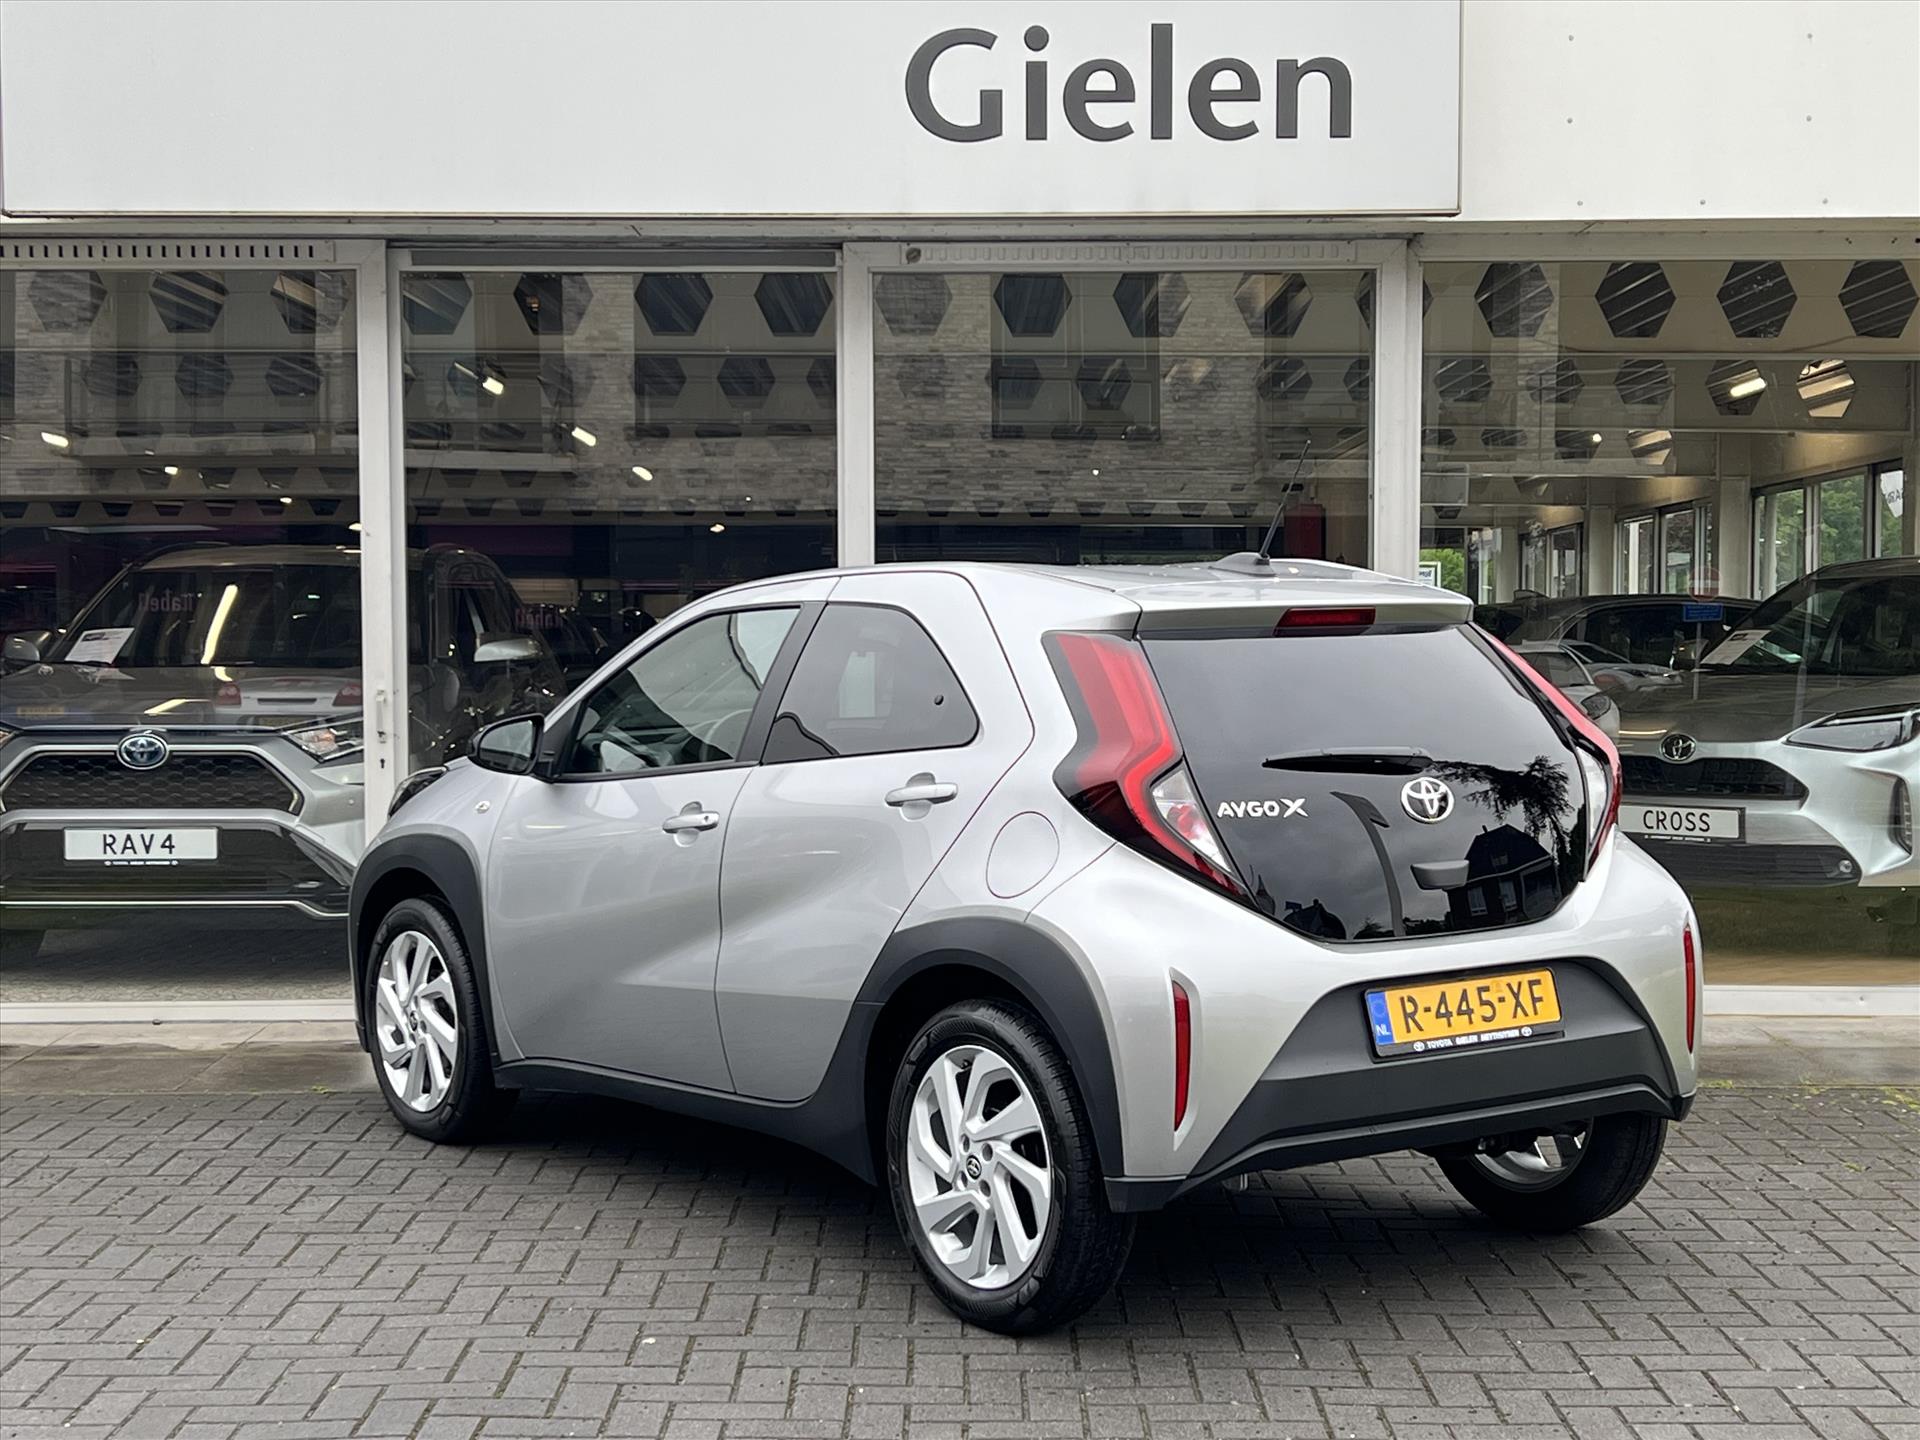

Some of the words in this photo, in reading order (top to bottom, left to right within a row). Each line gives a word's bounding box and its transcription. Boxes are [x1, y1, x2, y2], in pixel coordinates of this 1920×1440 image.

[905, 23, 1353, 142] Gielen
[1643, 810, 1711, 832] CROSS
[103, 834, 175, 855] RAV4
[1400, 978, 1544, 1034] R-445-XF
[1376, 1025, 1390, 1035] NL
[1427, 1038, 1454, 1050] TOYOTA
